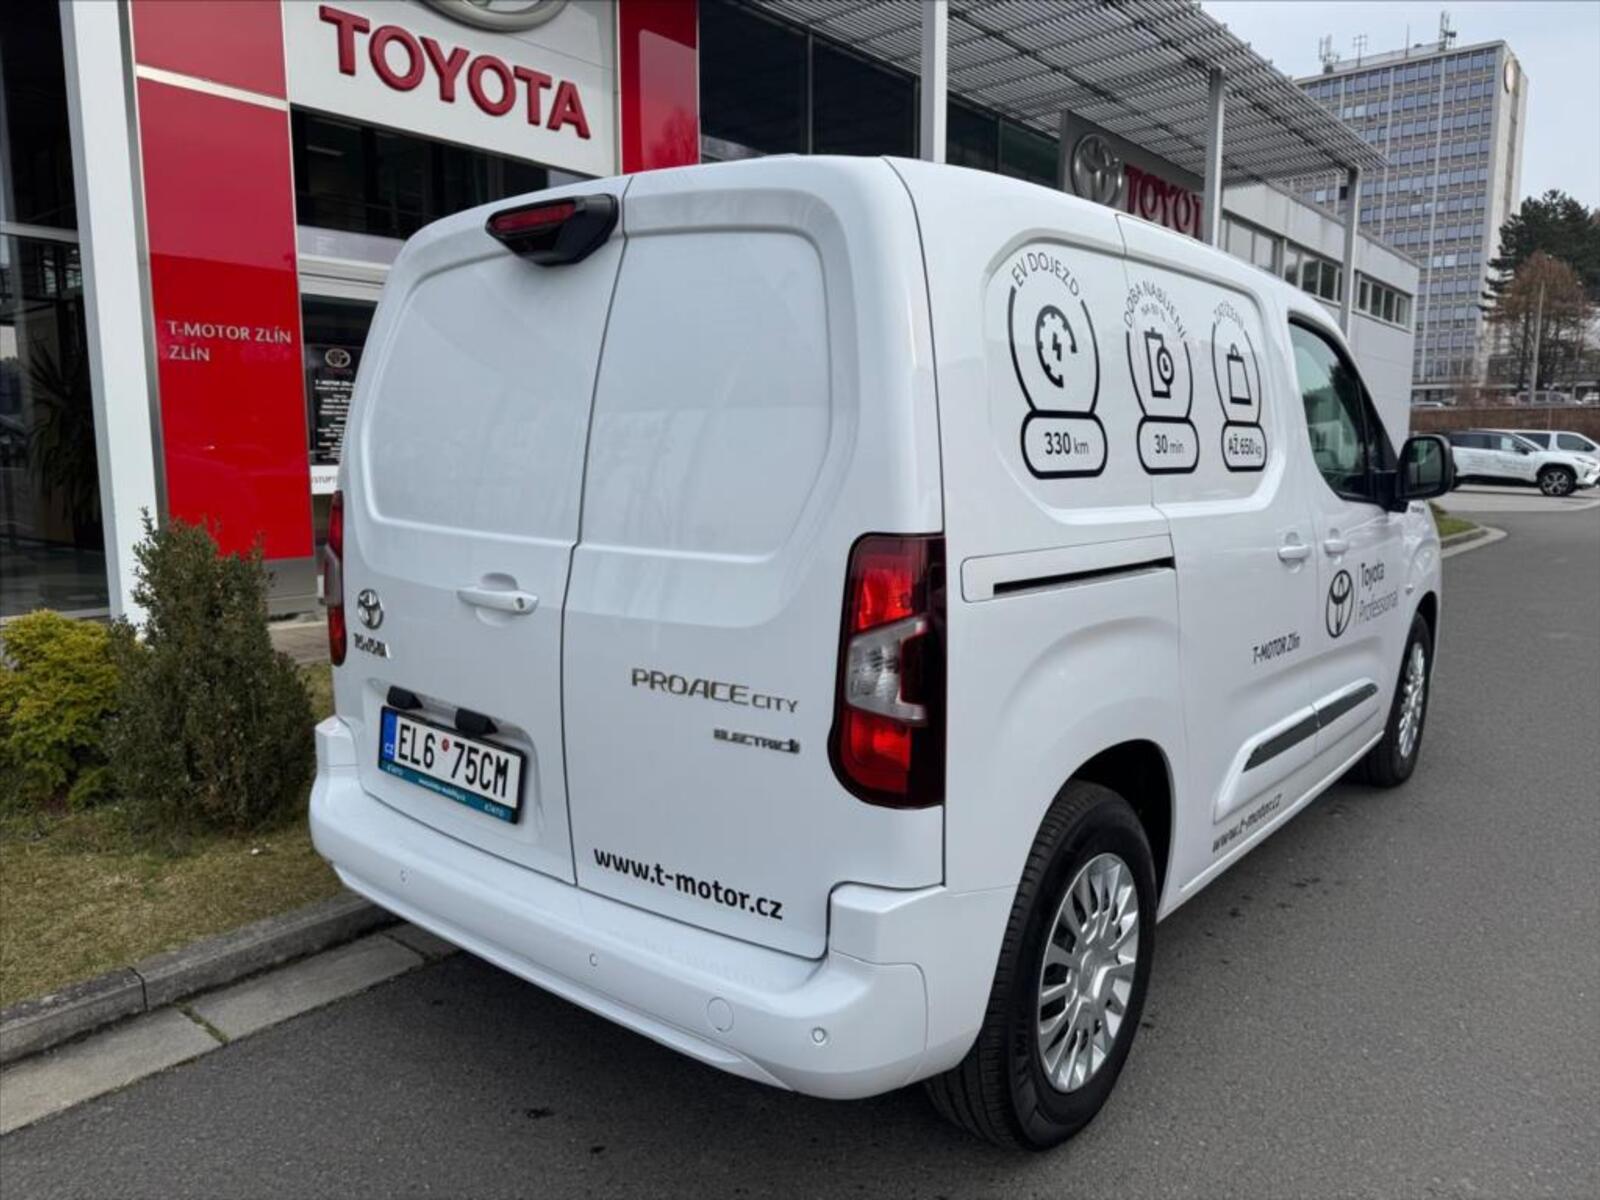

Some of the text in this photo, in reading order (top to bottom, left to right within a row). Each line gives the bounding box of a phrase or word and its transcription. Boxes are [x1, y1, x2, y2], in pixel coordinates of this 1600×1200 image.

[319, 5, 590, 139] TOYOTA
[1124, 163, 1203, 241] TOYOT
[1011, 252, 1079, 296] EV DOJEZD
[167, 320, 292, 344] T-MOTOR ZLÍN
[168, 343, 210, 361] ZLÍN
[1044, 432, 1089, 455] 330 km
[1154, 434, 1184, 454] 30 min
[1361, 562, 1384, 592] Toyota
[632, 668, 798, 713] PROACE CITY
[398, 723, 436, 769] EL6
[451, 741, 509, 798] 75CM
[593, 848, 783, 920] www.t-motor.cz
